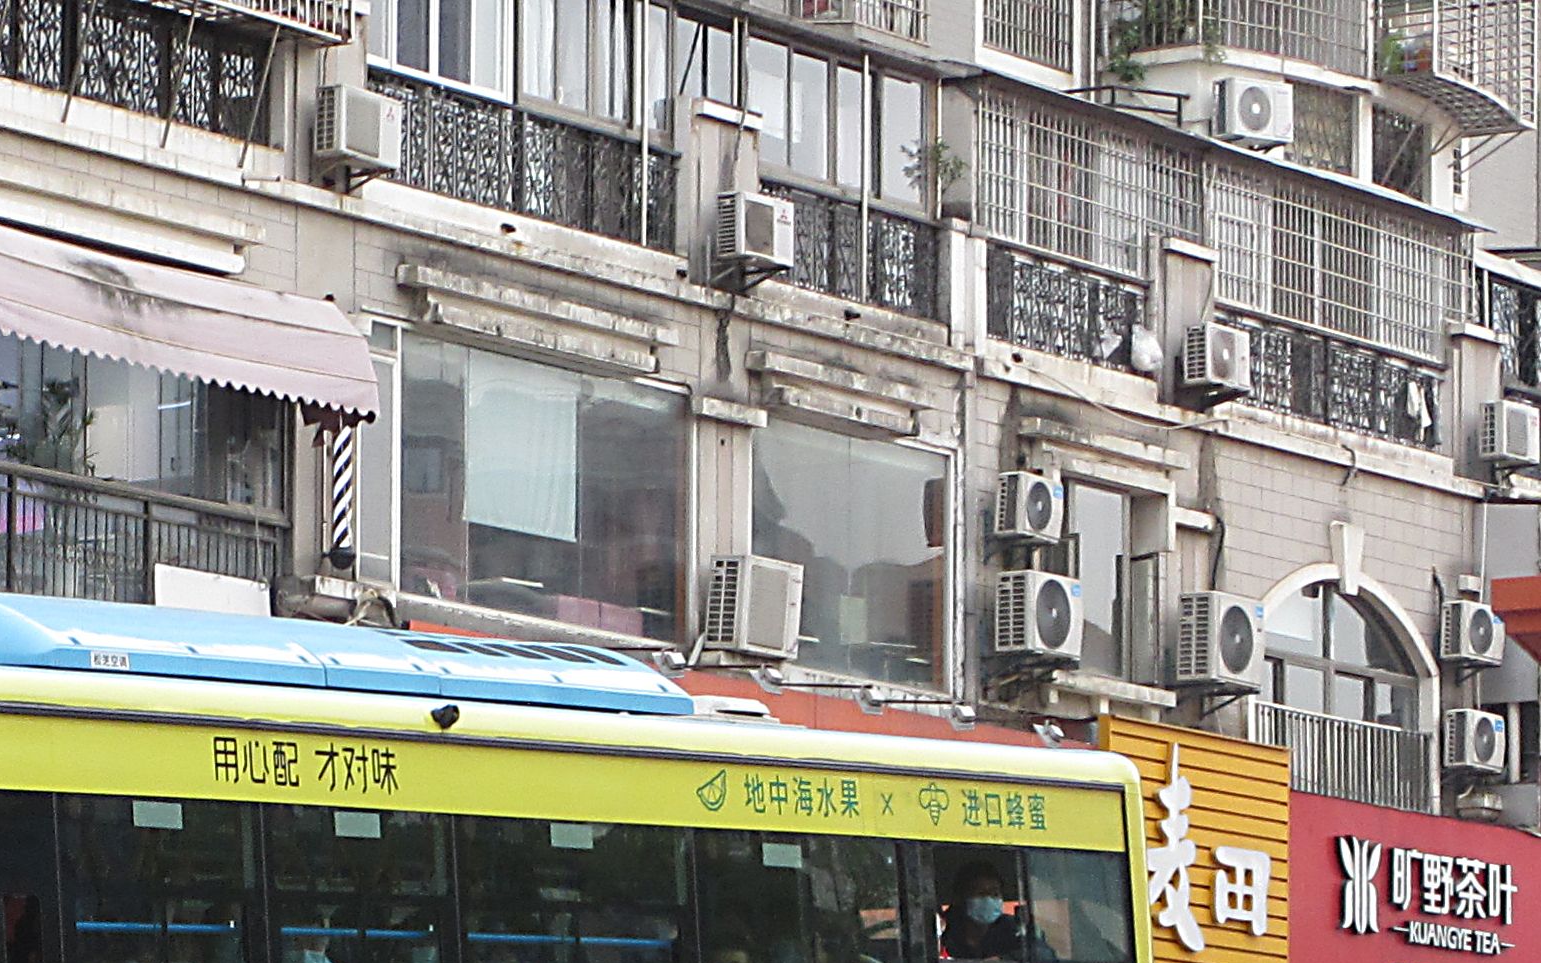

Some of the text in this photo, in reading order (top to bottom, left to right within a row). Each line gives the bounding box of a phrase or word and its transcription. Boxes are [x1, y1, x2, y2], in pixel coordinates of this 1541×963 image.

[213, 736, 399, 795] 用心配 才对味
[743, 774, 860, 819] 地中海水果
[961, 788, 1048, 831] 进口蜂蜜
[1392, 847, 1518, 925] 旷野茶叶
[1409, 920, 1502, 955] KUANGYE TEA
